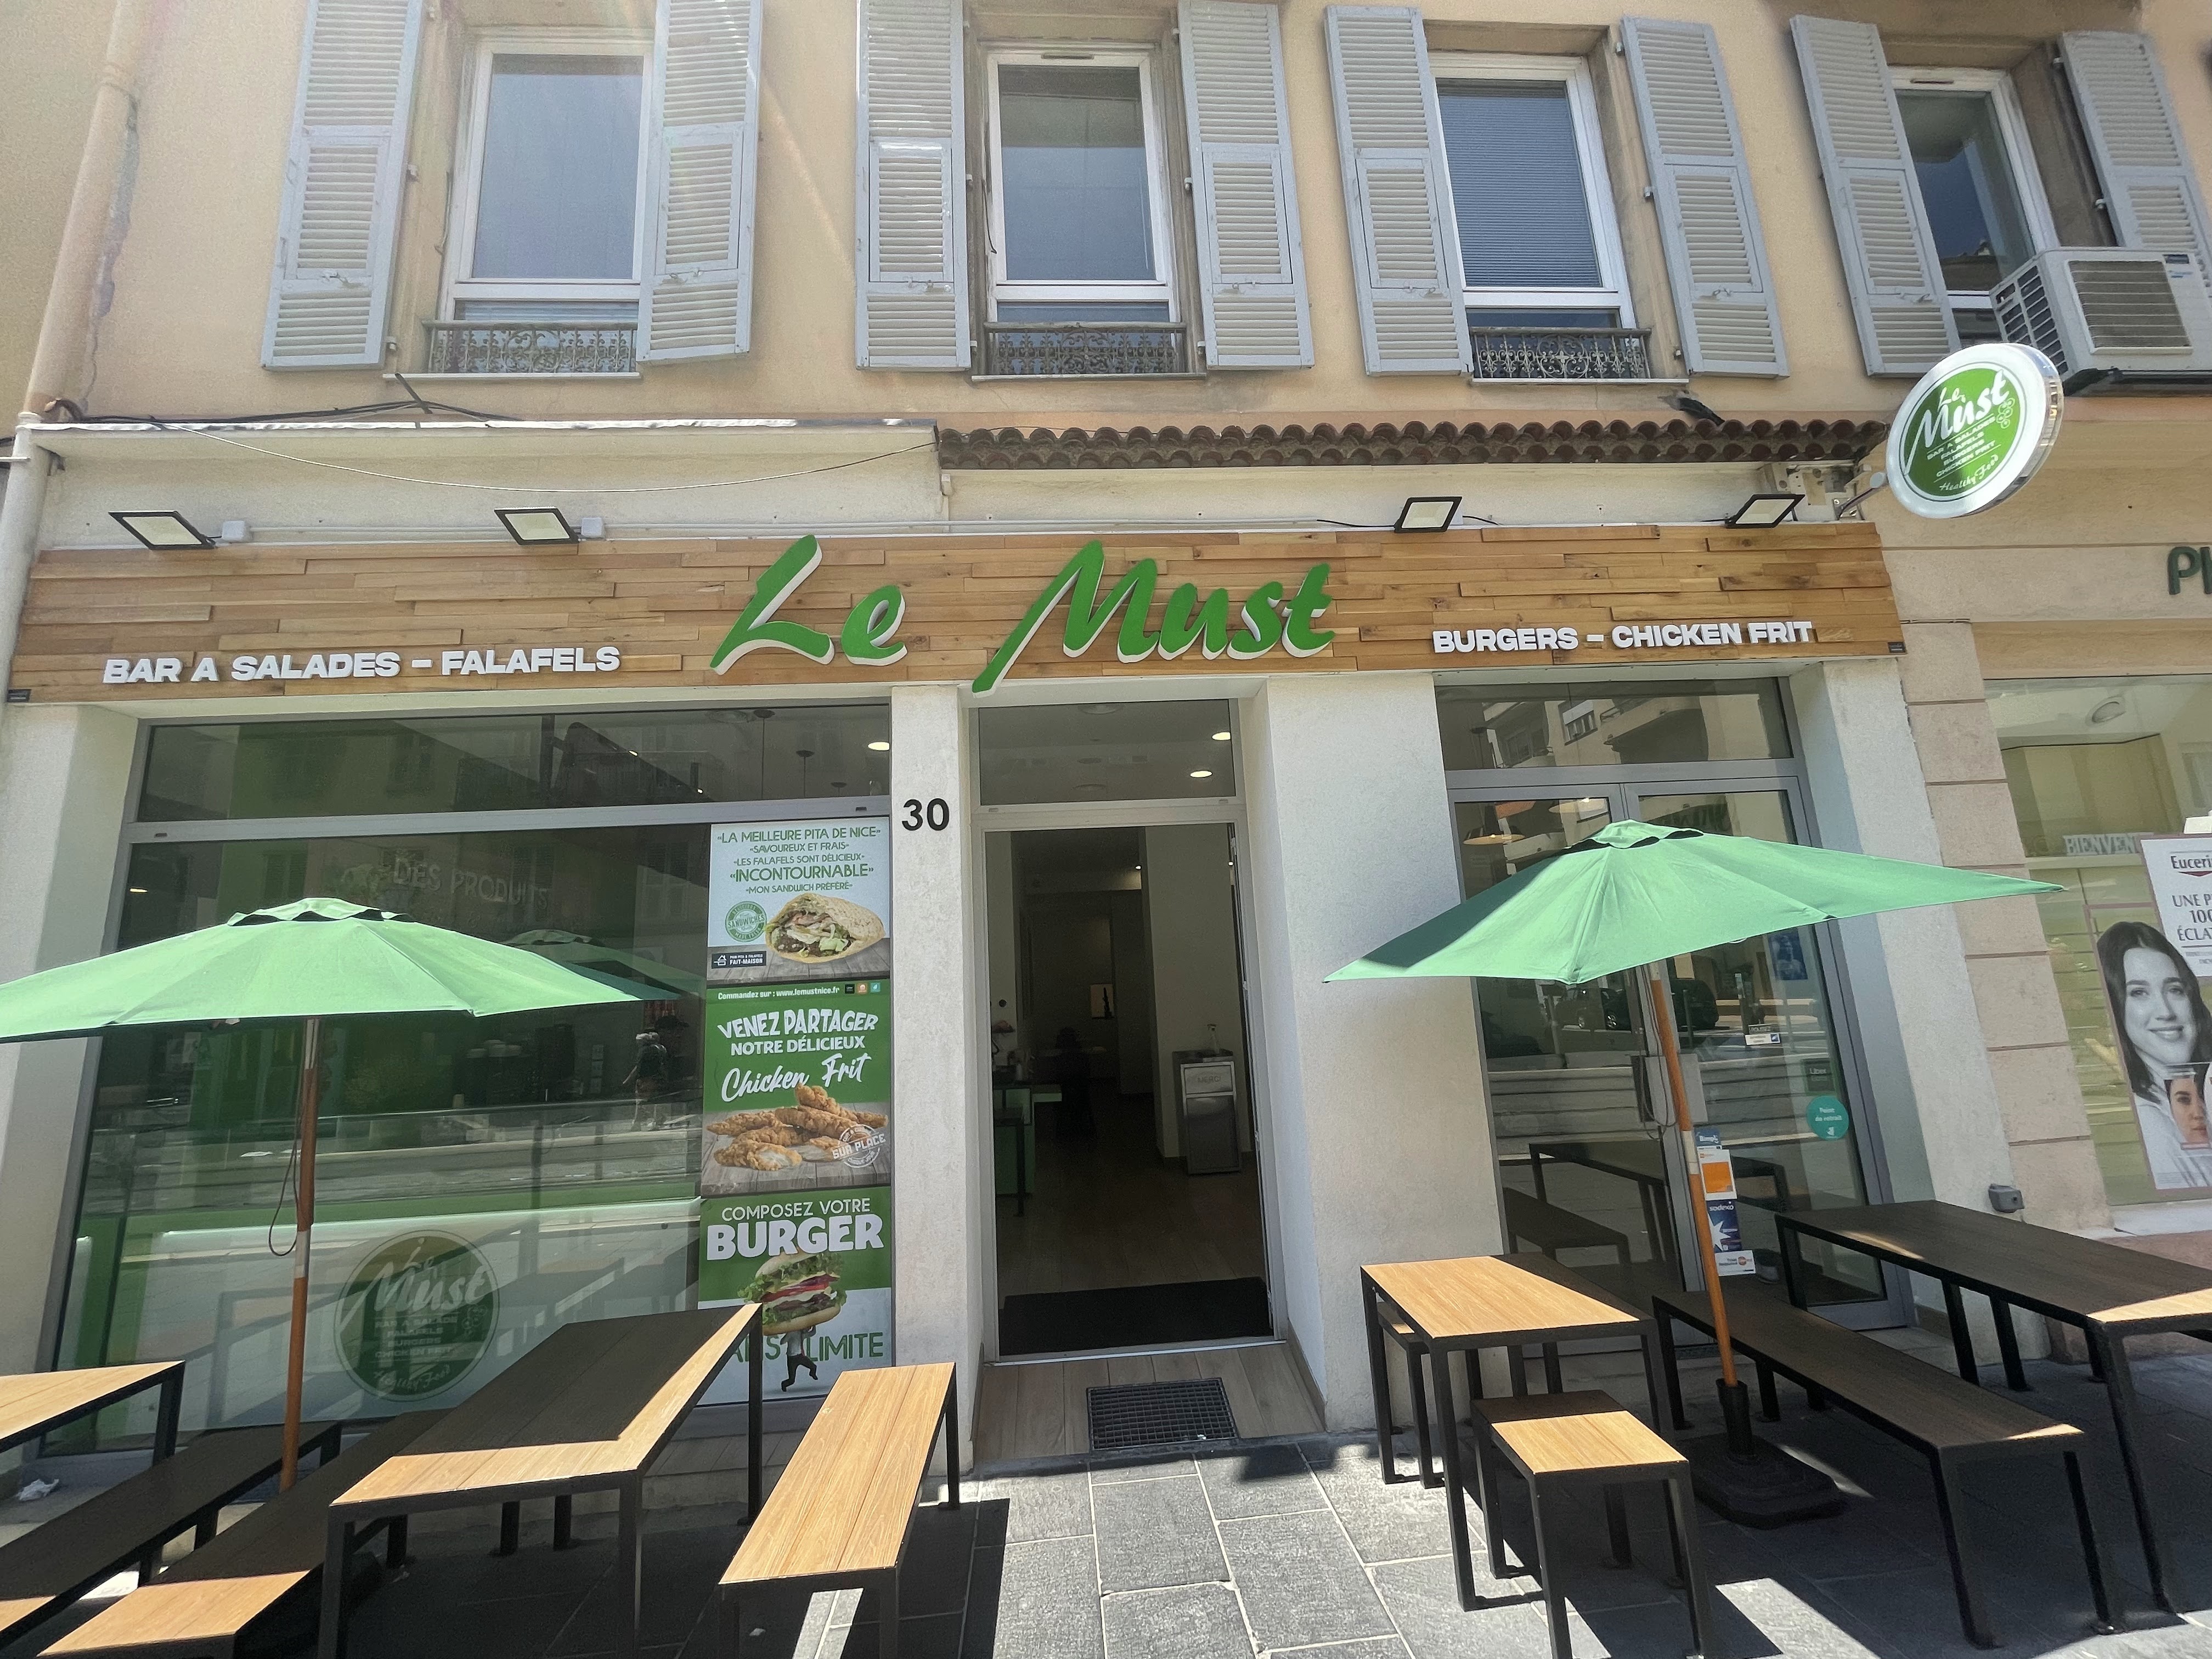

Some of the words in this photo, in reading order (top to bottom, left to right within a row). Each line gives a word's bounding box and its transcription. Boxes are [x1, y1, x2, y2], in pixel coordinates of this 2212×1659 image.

[1937, 386, 1966, 413] Le
[1905, 369, 2010, 476] Must
[710, 534, 907, 675] Le
[972, 540, 1336, 697] Must
[1432, 627, 1578, 653] BURGERS
[1612, 622, 1741, 648] CHICKEN
[1747, 620, 1813, 644] FRIT
[102, 657, 181, 684] BAR
[190, 657, 219, 682] A
[231, 651, 400, 681] SALADES
[442, 646, 621, 676] FALAFELS
[902, 798, 950, 831] 30
[741, 830, 802, 843] MEILLEURE
[805, 828, 830, 840] PITA
[832, 827, 847, 838] DE
[808, 842, 818, 851] ET
[753, 856, 794, 865] FALAFELS
[797, 854, 820, 863] SONT
[2170, 855, 2212, 869] Euceri
[772, 883, 814, 893] SANDWICH
[2172, 894, 2202, 907] UNE
[2203, 893, 2212, 906] P
[728, 914, 765, 929] SANDWICHES
[717, 1011, 781, 1038] VENEZ
[783, 1008, 878, 1035] PARTAGER
[731, 1040, 784, 1056] NOTRE
[787, 1035, 865, 1053] DÉLICIEUX
[721, 1065, 810, 1102] Chicken
[822, 1052, 872, 1087] Frit
[832, 1144, 853, 1159] SUR
[854, 1133, 887, 1152] PLACE
[721, 1201, 814, 1222] COMPOSEZ
[819, 1198, 871, 1215] VOTRE
[1709, 1204, 1734, 1212] sodexo
[707, 1214, 884, 1261] BURGER
[339, 1261, 490, 1331] Must
[806, 1331, 883, 1362] LIMITE
